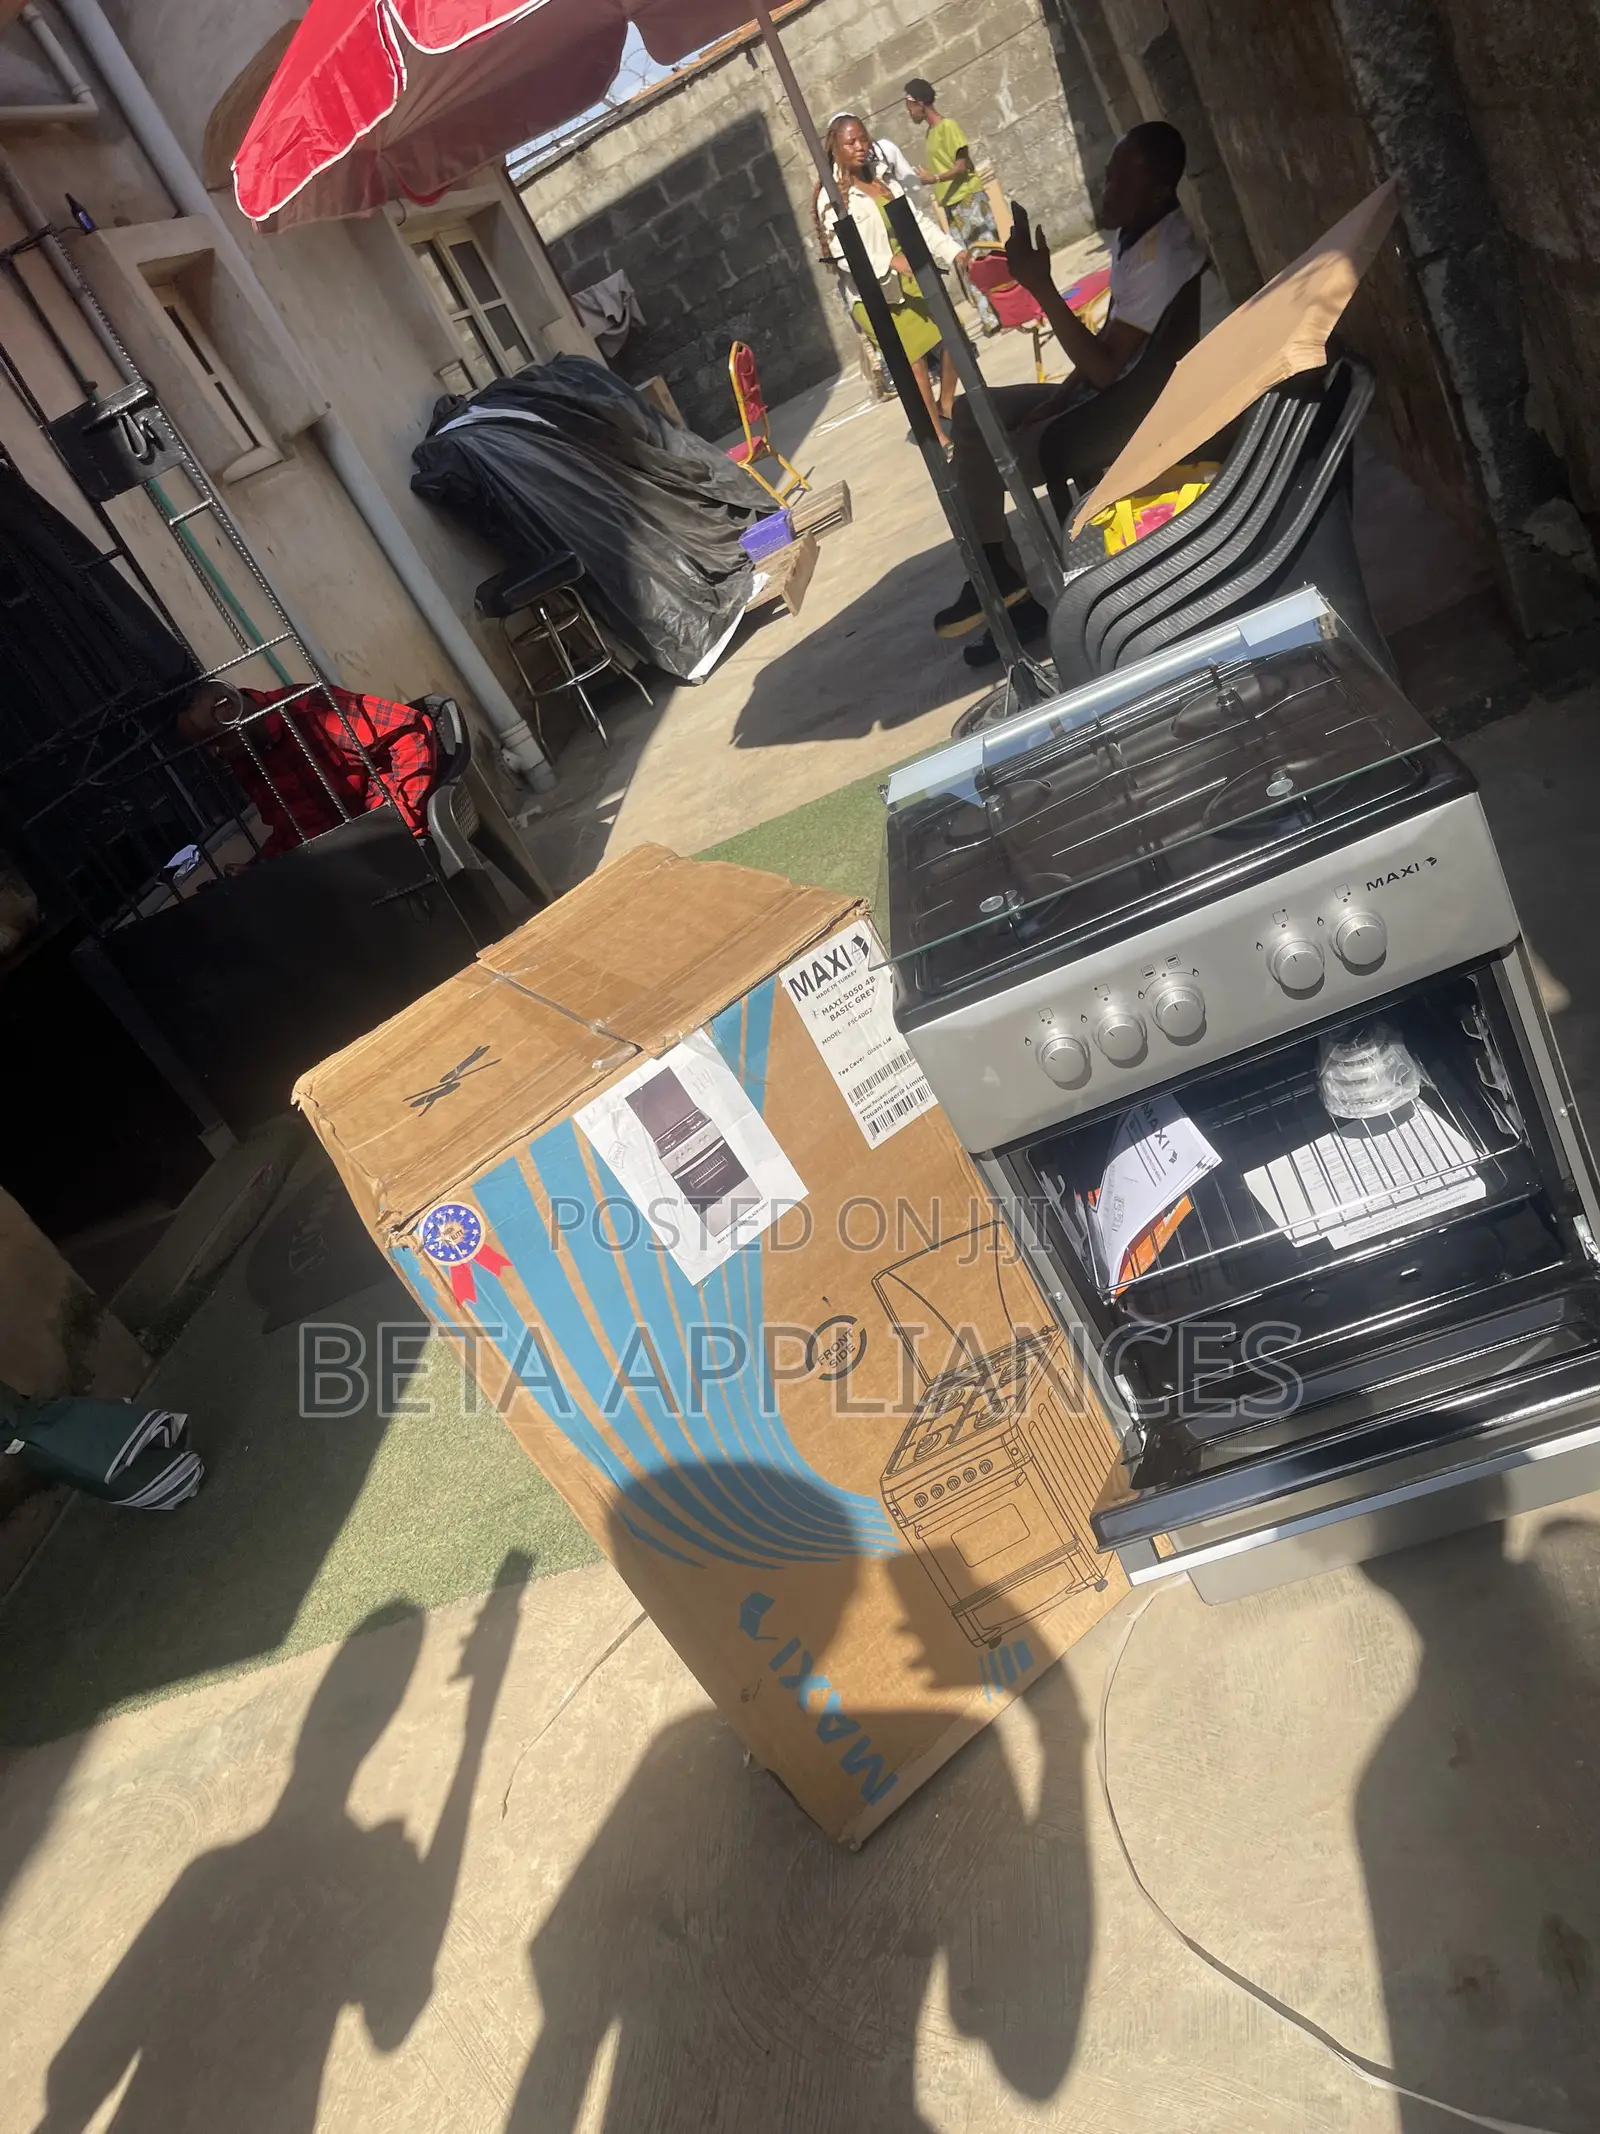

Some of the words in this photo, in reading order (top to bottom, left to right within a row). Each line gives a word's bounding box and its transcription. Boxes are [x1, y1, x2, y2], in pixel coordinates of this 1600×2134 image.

[1366, 862, 1420, 892] MAXI
[788, 944, 853, 1002] MAXI
[816, 988, 830, 1000] MADE
[838, 969, 857, 984] TURKEY
[821, 997, 843, 1016] MAXI
[843, 983, 864, 1001] 5050
[865, 975, 876, 986] 4B
[829, 1001, 854, 1021] BASIC
[854, 986, 875, 1004] GREY
[867, 1044, 883, 1056] Glass
[862, 1105, 883, 1122] Fouani
[883, 1088, 905, 1105] Nigeria
[1141, 1103, 1170, 1150] MAXI
[817, 1328, 853, 1366] FRONT
[829, 1344, 856, 1368] SIDE
[769, 1637, 899, 1806] MAXI
